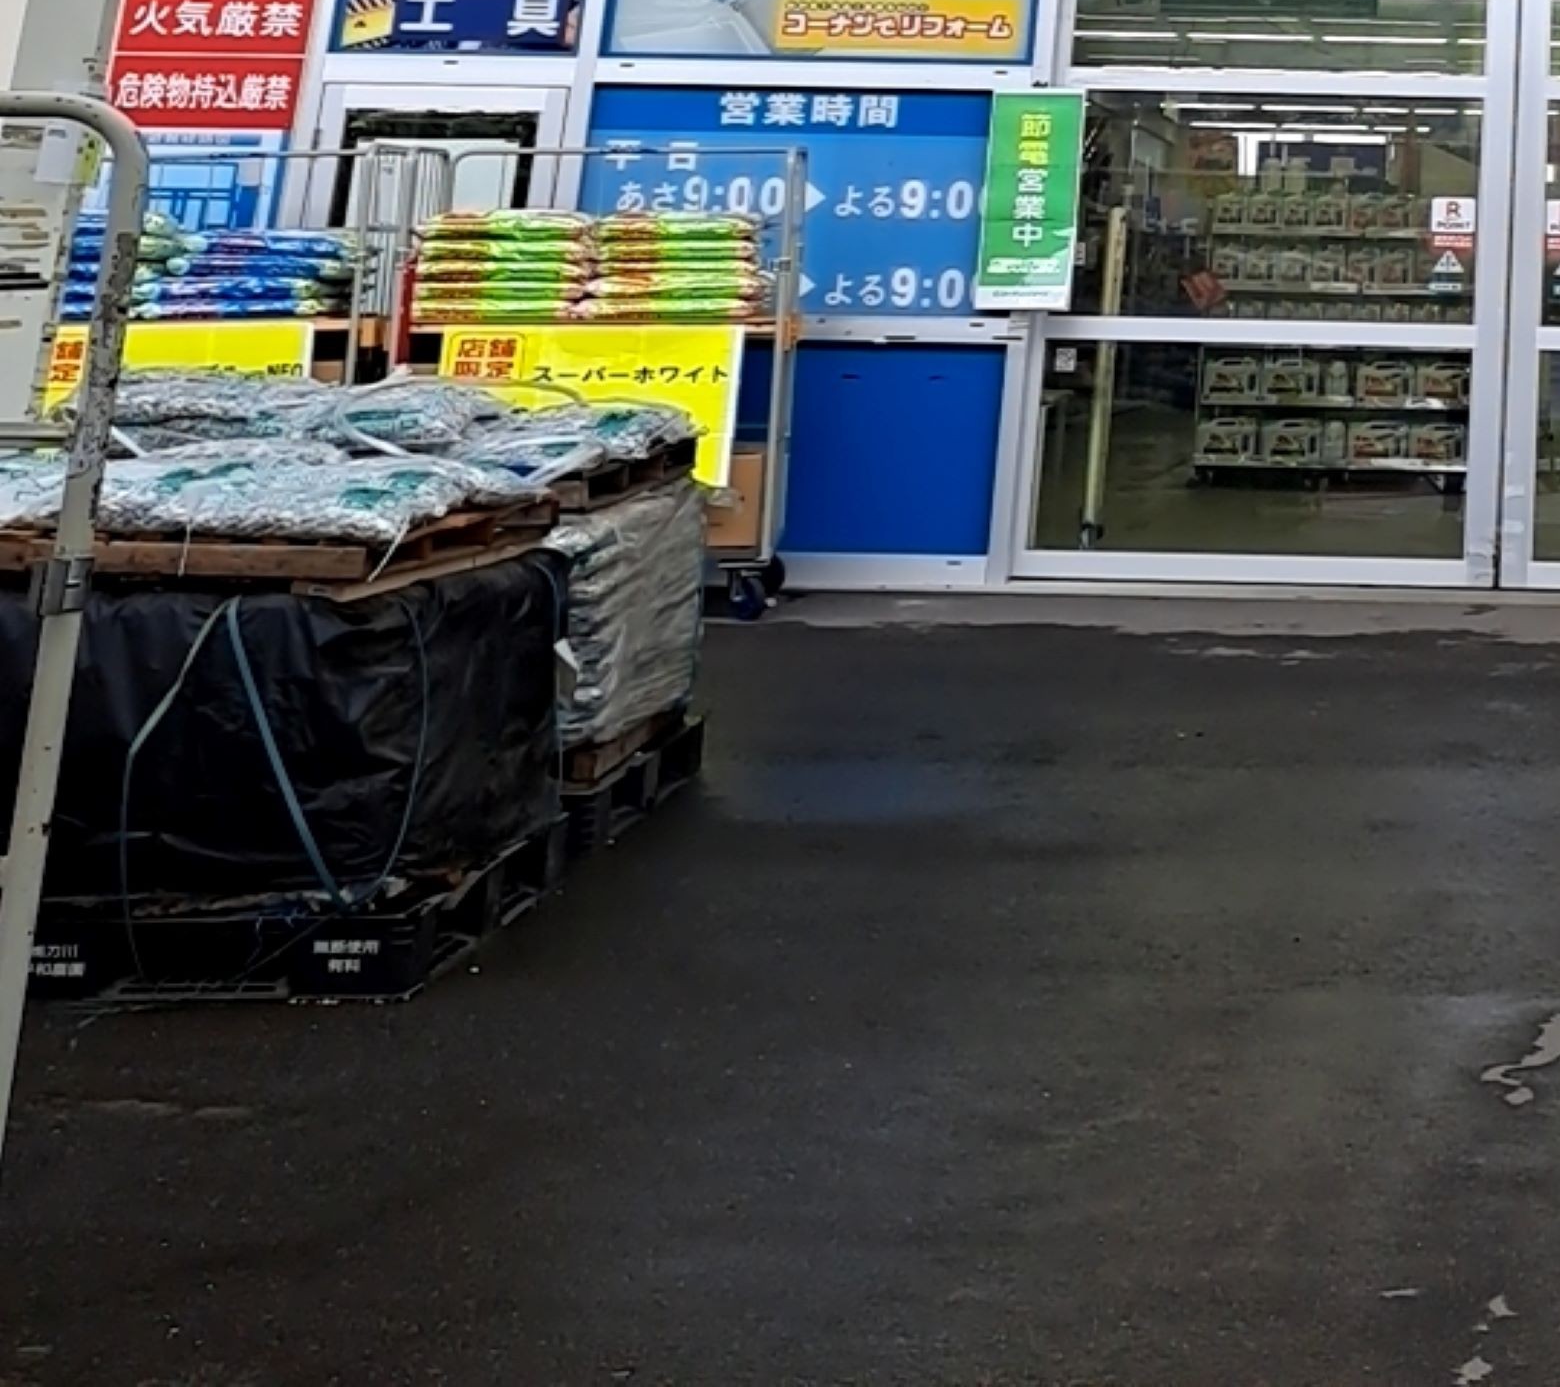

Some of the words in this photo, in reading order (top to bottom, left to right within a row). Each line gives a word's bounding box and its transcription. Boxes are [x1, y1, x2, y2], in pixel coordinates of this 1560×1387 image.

[129, 0, 304, 38] 火気厳禁
[783, 12, 1013, 39] コーナンでリフォーム
[115, 73, 292, 110] 危険物持込厳禁
[719, 91, 900, 128] 営業時間
[834, 179, 984, 219] よる9:0
[1012, 113, 1052, 248] 節電営業中
[824, 267, 975, 309] よる9:0
[532, 365, 730, 384] スーパーホワイト
